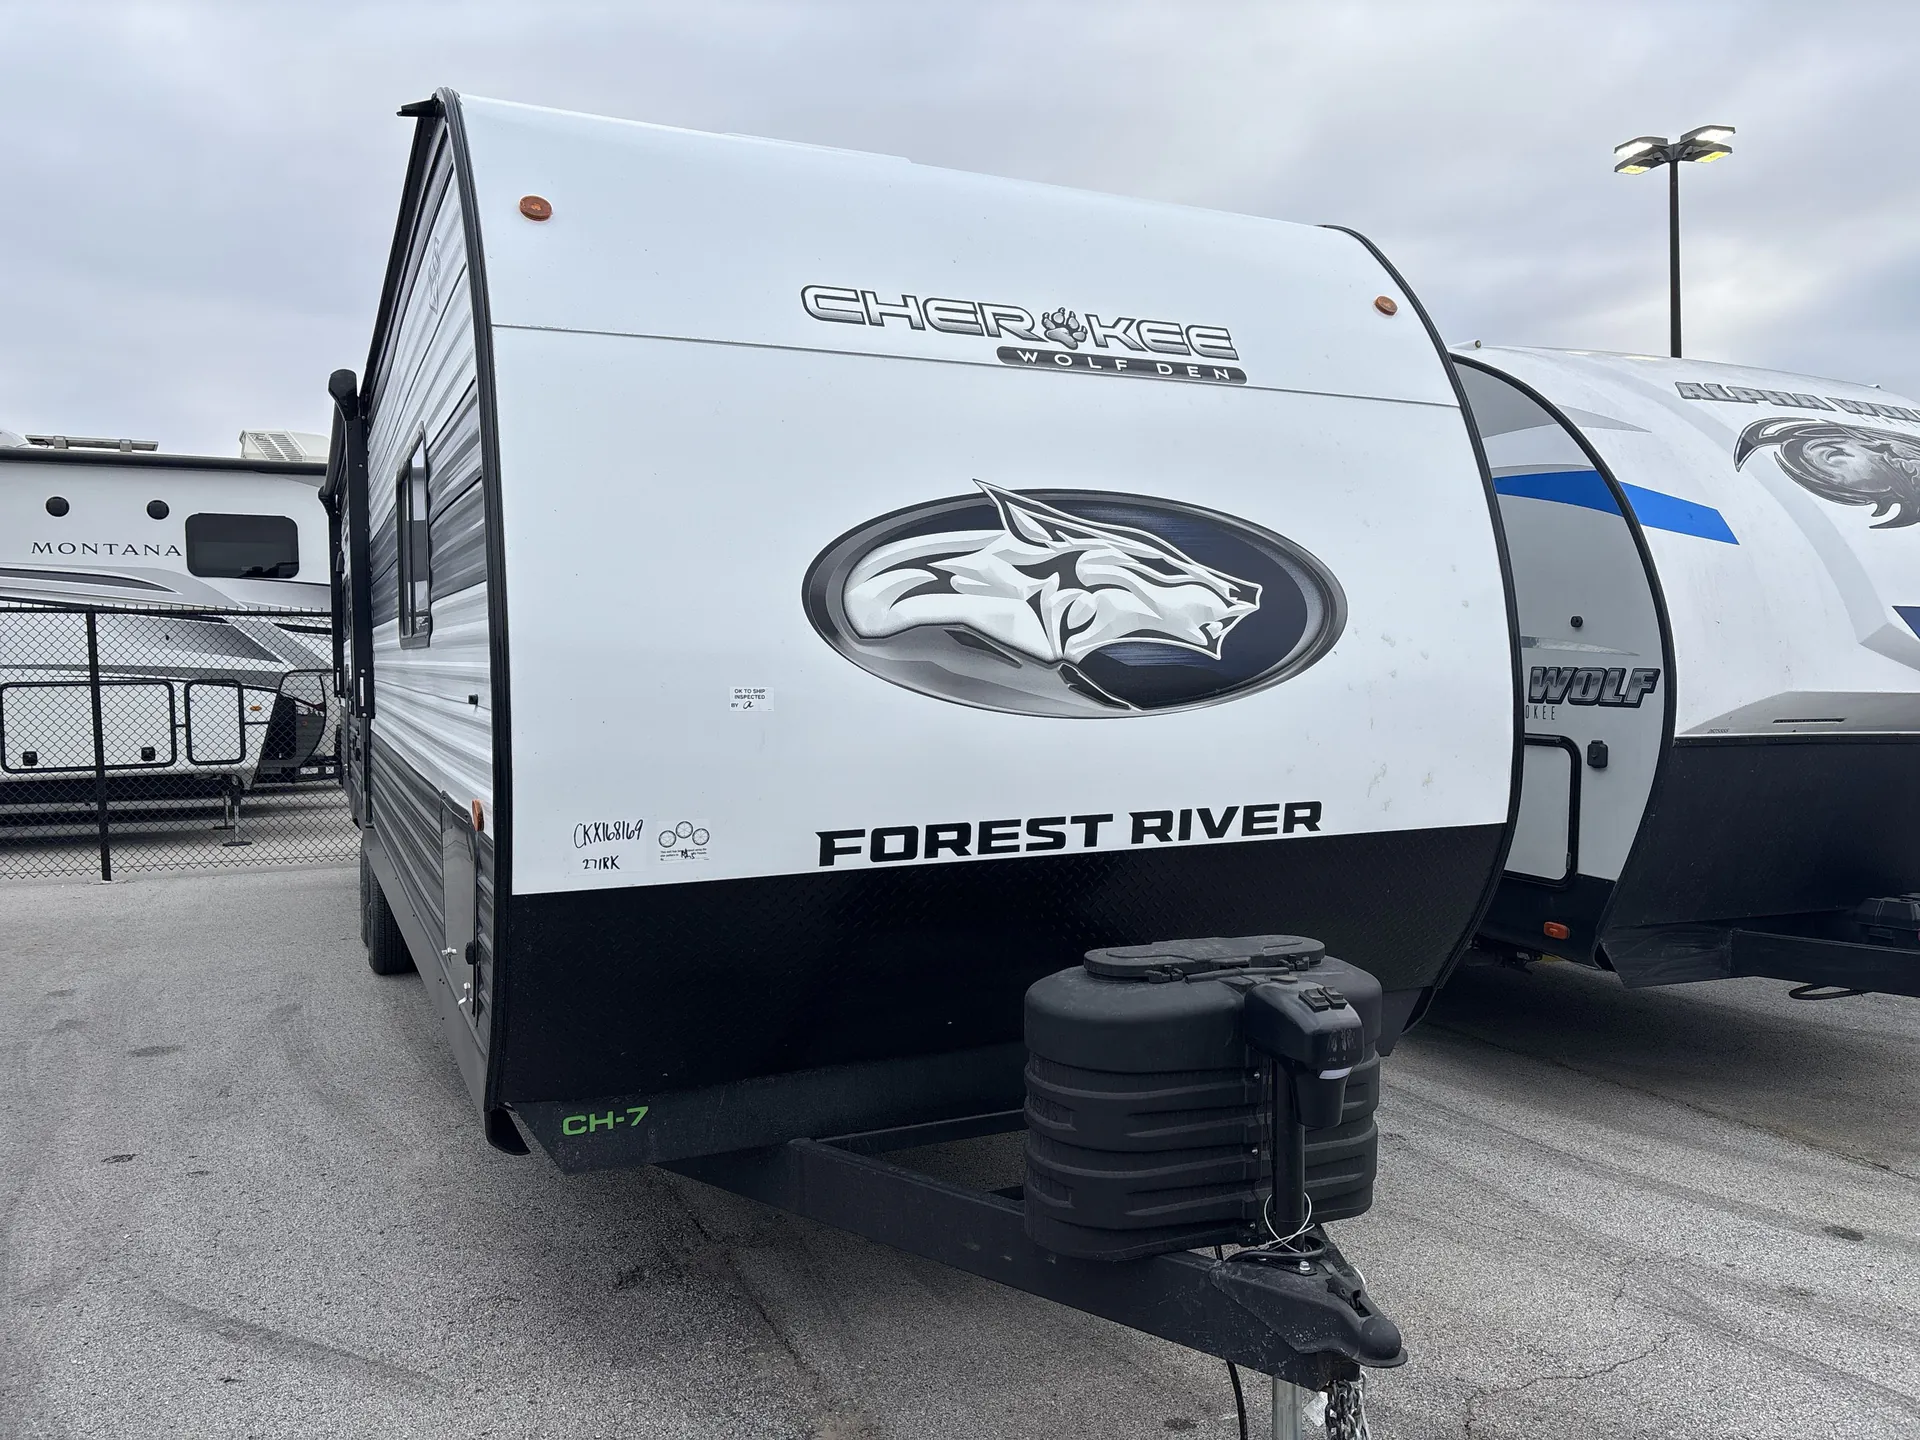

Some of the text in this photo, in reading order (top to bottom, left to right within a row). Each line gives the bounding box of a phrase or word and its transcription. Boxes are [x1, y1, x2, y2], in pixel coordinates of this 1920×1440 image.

[1017, 350, 1231, 380] WOLF DEN
[1675, 381, 1837, 412] ALPHA
[1824, 396, 1920, 422] WOL
[31, 542, 183, 556] MONTANA
[1528, 666, 1661, 709] WOLF
[815, 800, 1322, 867] FOREST RIVER
[562, 1105, 649, 1136] CH-7
